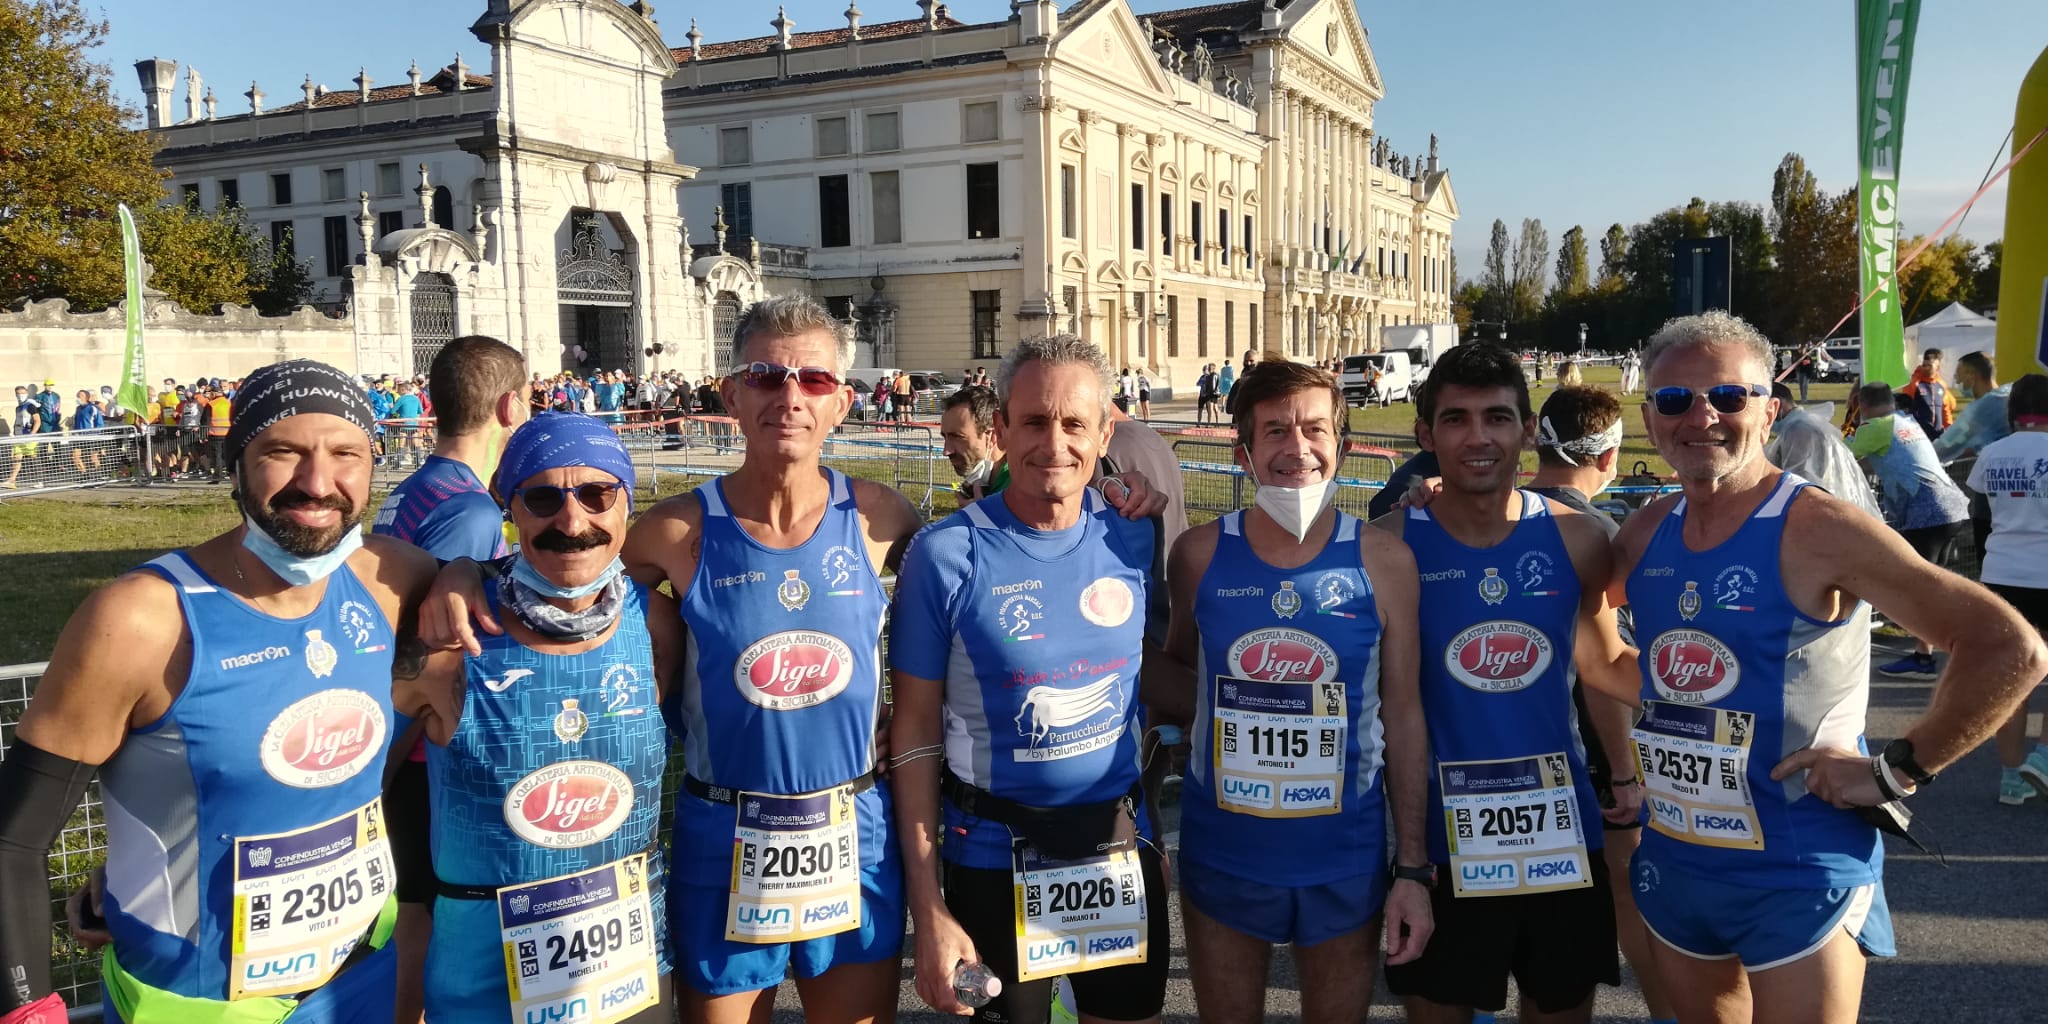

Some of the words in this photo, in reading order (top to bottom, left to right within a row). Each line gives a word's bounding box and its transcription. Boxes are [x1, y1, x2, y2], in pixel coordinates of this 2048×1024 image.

[280, 387, 355, 408] HUAWEI
[1986, 468, 2028, 480] TRAVEL
[714, 570, 766, 588] macron
[992, 580, 1042, 596] macron
[1218, 586, 1264, 597] macron
[1497, 624, 1549, 653] ARTIGIANALE
[220, 646, 290, 670] macron
[1283, 631, 1334, 668] ARTIGIANALE
[1466, 634, 1534, 676] Sigel
[754, 646, 835, 692] Sigel
[1246, 640, 1319, 682] Sigel
[1660, 641, 1720, 687] Sigel
[1490, 678, 1524, 690] SICILIA
[782, 693, 819, 708] SICILIA
[1238, 696, 1280, 704] CONFINDUSTRIA
[1674, 692, 1705, 702] SICILIA
[289, 710, 368, 766] Sigel
[1049, 718, 1110, 744] Parrucchieri
[1032, 750, 1044, 760] by
[1048, 742, 1092, 758] Palumbo
[1248, 726, 1309, 758] 1115
[1258, 760, 1284, 768] ANTONIO
[1655, 748, 1712, 786] 2537
[572, 764, 629, 798] ARTIGIANALE
[528, 776, 614, 829] Sigel
[1283, 786, 1330, 802] HOKA
[1478, 804, 1547, 837] 2057
[1696, 815, 1747, 831] HOKA
[556, 829, 598, 845] SICILIA
[1498, 838, 1524, 846] MICHELE
[274, 845, 330, 864] CONFINDUSTRIA
[762, 842, 833, 878] 2030
[1528, 860, 1577, 878] HOKA
[758, 882, 785, 890] THIERRY
[786, 880, 823, 890] MAXIMILIEN
[282, 868, 362, 926] 2305
[532, 894, 586, 910] CONFINDUSTRIA
[1048, 877, 1115, 913] 2026
[803, 900, 849, 924] HOKA
[1062, 914, 1088, 923] DAMIANO
[309, 922, 325, 932] VITO
[546, 918, 622, 972] 2499
[1088, 936, 1134, 954] HOKA
[568, 964, 598, 980] MICHELE
[601, 977, 644, 1010] HOKA
